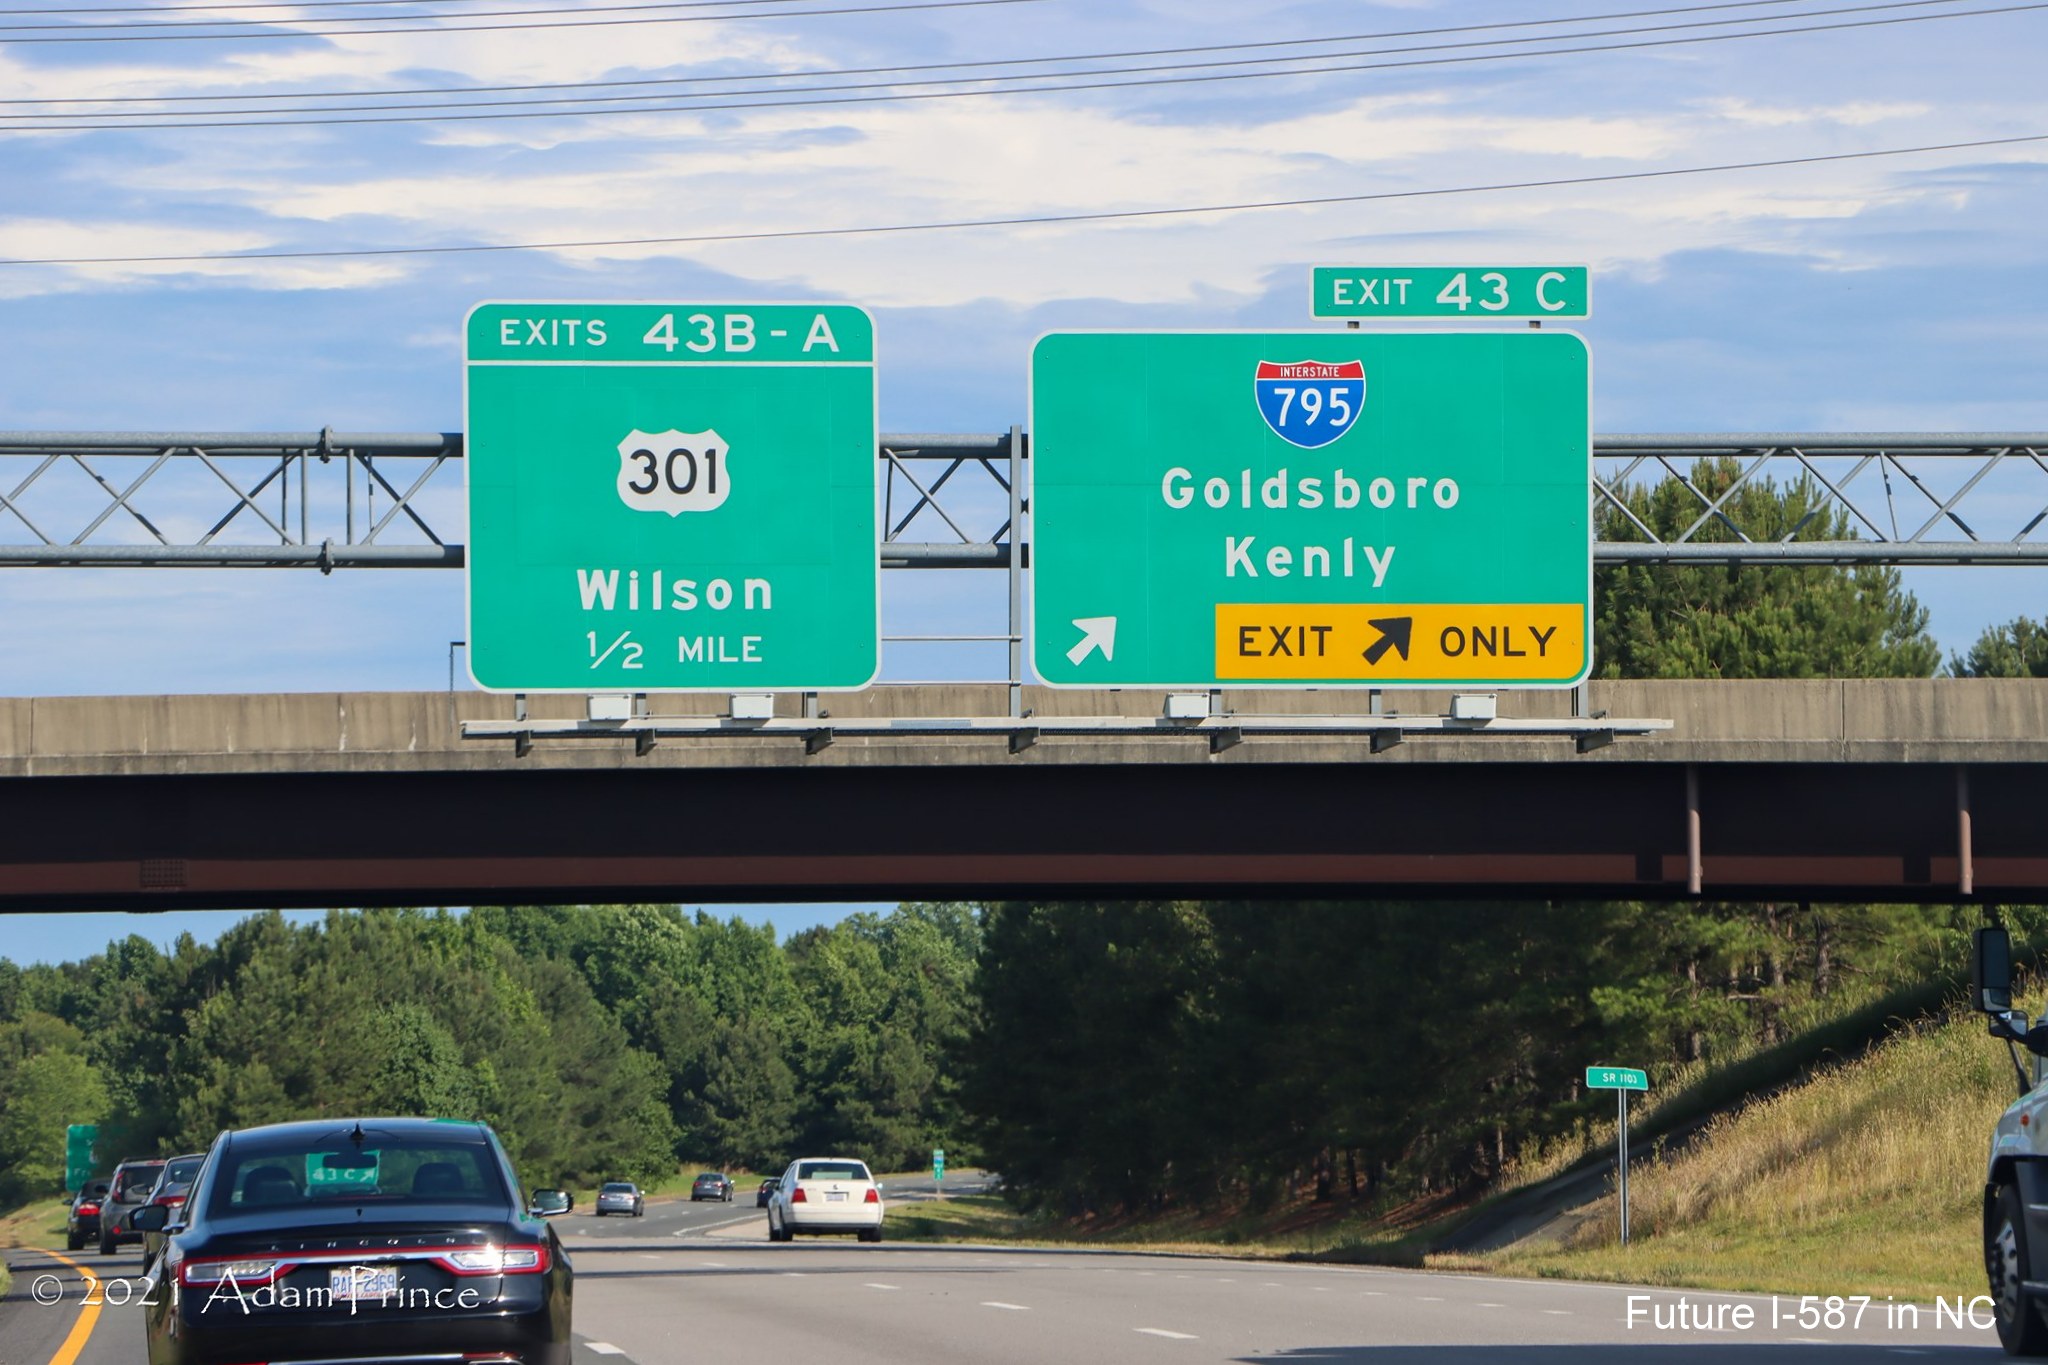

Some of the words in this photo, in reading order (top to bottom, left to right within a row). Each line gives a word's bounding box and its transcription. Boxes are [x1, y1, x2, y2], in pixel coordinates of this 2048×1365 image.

[1333, 279, 1412, 305] EXIT
[1436, 273, 1510, 311] 43
[1536, 272, 1566, 311] C
[500, 319, 608, 346] EXITS
[1280, 365, 1340, 378] INTERSTATE
[1274, 387, 1351, 427] 795
[628, 448, 716, 495] 301
[1161, 466, 1460, 509] Goldsboro
[1225, 536, 1396, 588] Kenly
[576, 569, 772, 611] Wilson
[586, 631, 643, 669] 1/2
[678, 636, 763, 663] MILE
[1239, 626, 1333, 657] EXIT
[1440, 626, 1557, 657] ONLY
[1602, 1072, 1616, 1083] SR
